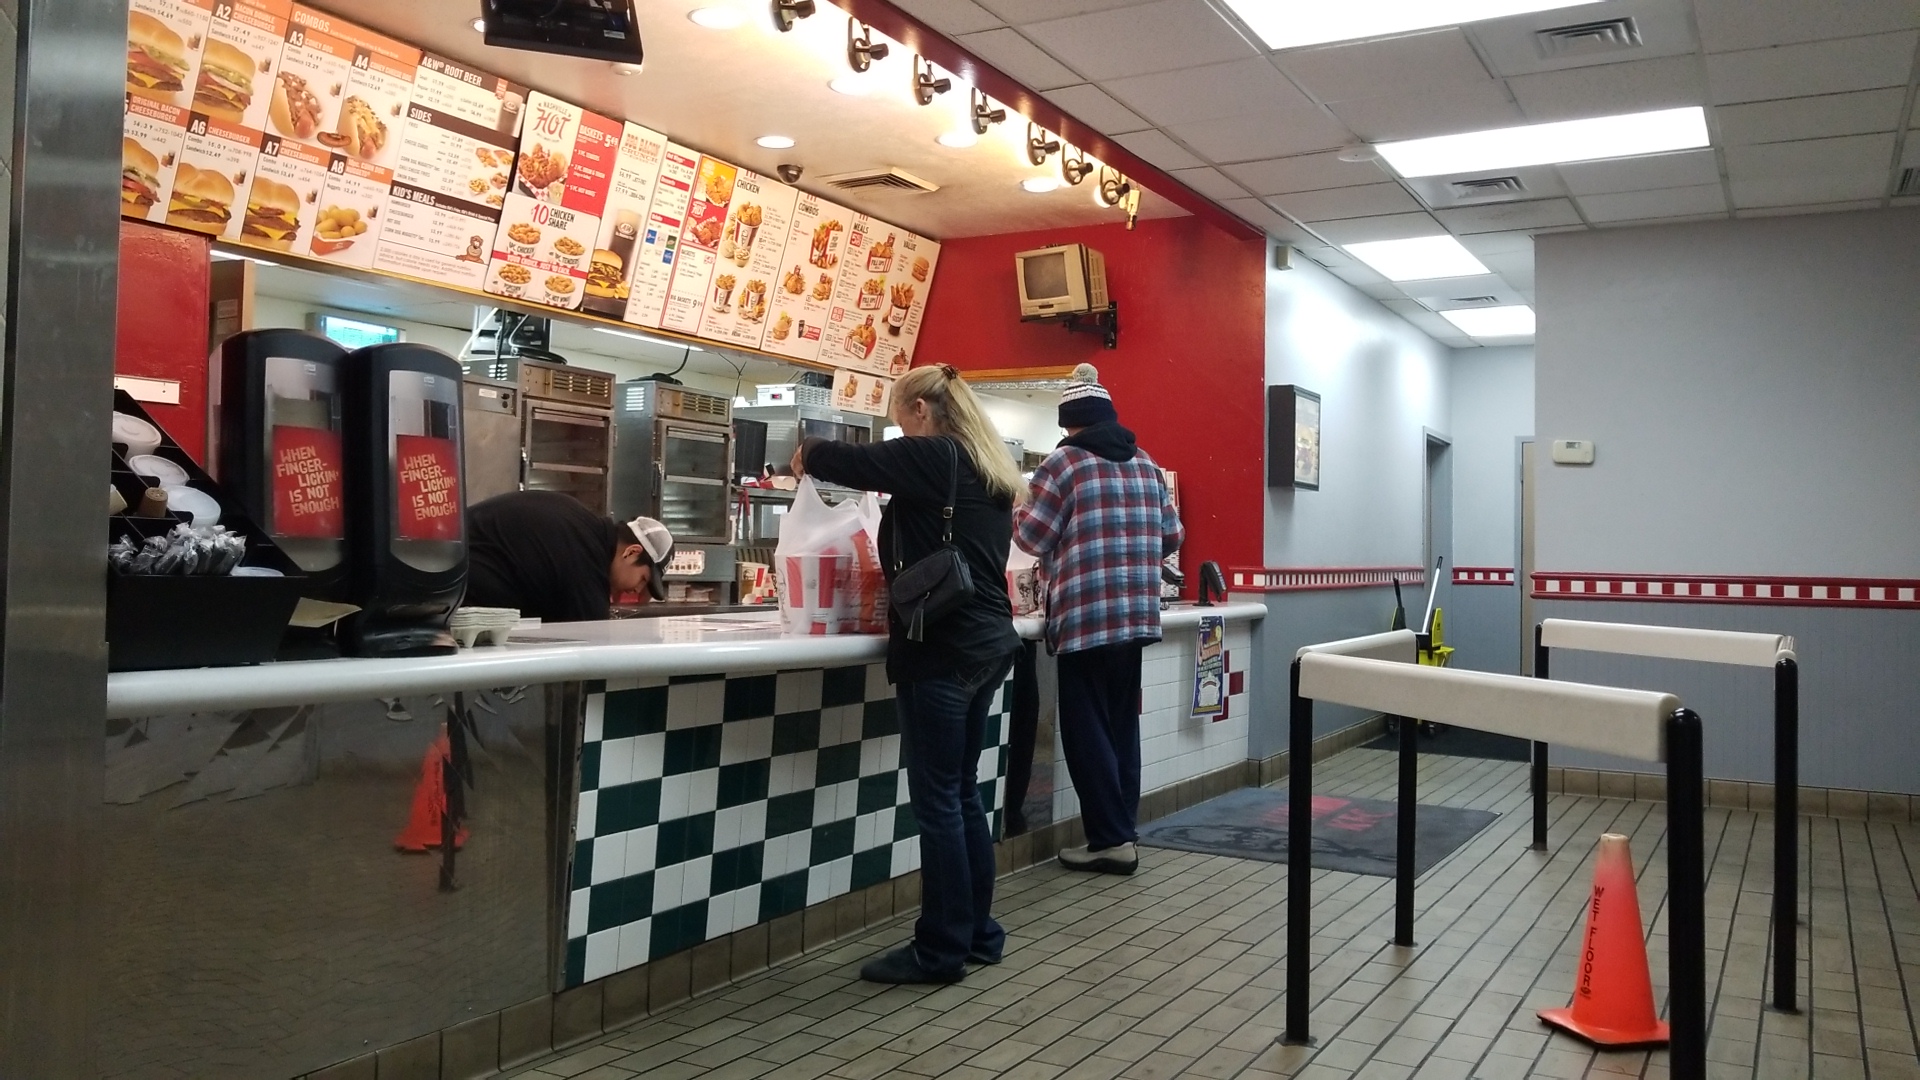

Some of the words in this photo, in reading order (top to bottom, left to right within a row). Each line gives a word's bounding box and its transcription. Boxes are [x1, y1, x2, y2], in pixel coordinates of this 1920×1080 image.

[216, 3, 232, 20] A2
[233, 12, 275, 33] CHEESEBURGER
[294, 11, 330, 32] COMBOS
[289, 31, 304, 46] A3
[355, 55, 369, 69] A4
[444, 64, 465, 81] ROOT
[463, 71, 483, 87] BEER
[131, 104, 177, 123] CHEESEBURGER
[133, 96, 160, 112] ORIGINAL
[161, 104, 181, 116] BACON
[544, 101, 568, 114] NASHVILLE
[410, 107, 432, 123] SIDES
[533, 107, 571, 139] HOT
[190, 119, 206, 135] A6
[208, 126, 251, 144] CHEESEBURGER
[580, 124, 604, 141] BASKETS
[188, 136, 202, 145] Combo
[264, 141, 280, 155] A7
[282, 140, 303, 151] DOUBLE
[186, 145, 205, 155] Sandwich
[280, 148, 320, 164] CHEESEBURGER
[622, 147, 658, 163] CRUNCH
[331, 159, 345, 174] A8
[737, 179, 760, 194] CHICKEN
[392, 185, 412, 200] KID'S
[412, 190, 436, 206] MEALS
[550, 208, 576, 224] CHICKEN
[798, 202, 819, 216] COMBOS
[548, 218, 568, 231] SHARE
[853, 222, 869, 234] MEALS
[903, 240, 917, 252] VALUE
[507, 255, 520, 264] YOUR
[280, 445, 316, 464] WHEN
[403, 453, 436, 471] WHEN
[276, 458, 327, 478] FINGER-
[400, 465, 446, 484] FINGER-
[298, 469, 339, 488] LICKIN'
[420, 477, 456, 493] LICKIN'
[289, 490, 302, 503] IS
[307, 484, 330, 499] NOT
[412, 496, 424, 508] IS
[429, 490, 449, 504] NOT
[292, 497, 339, 517] ENOUGH
[415, 502, 457, 521] ENOUGH
[1593, 885, 1604, 922] WET
